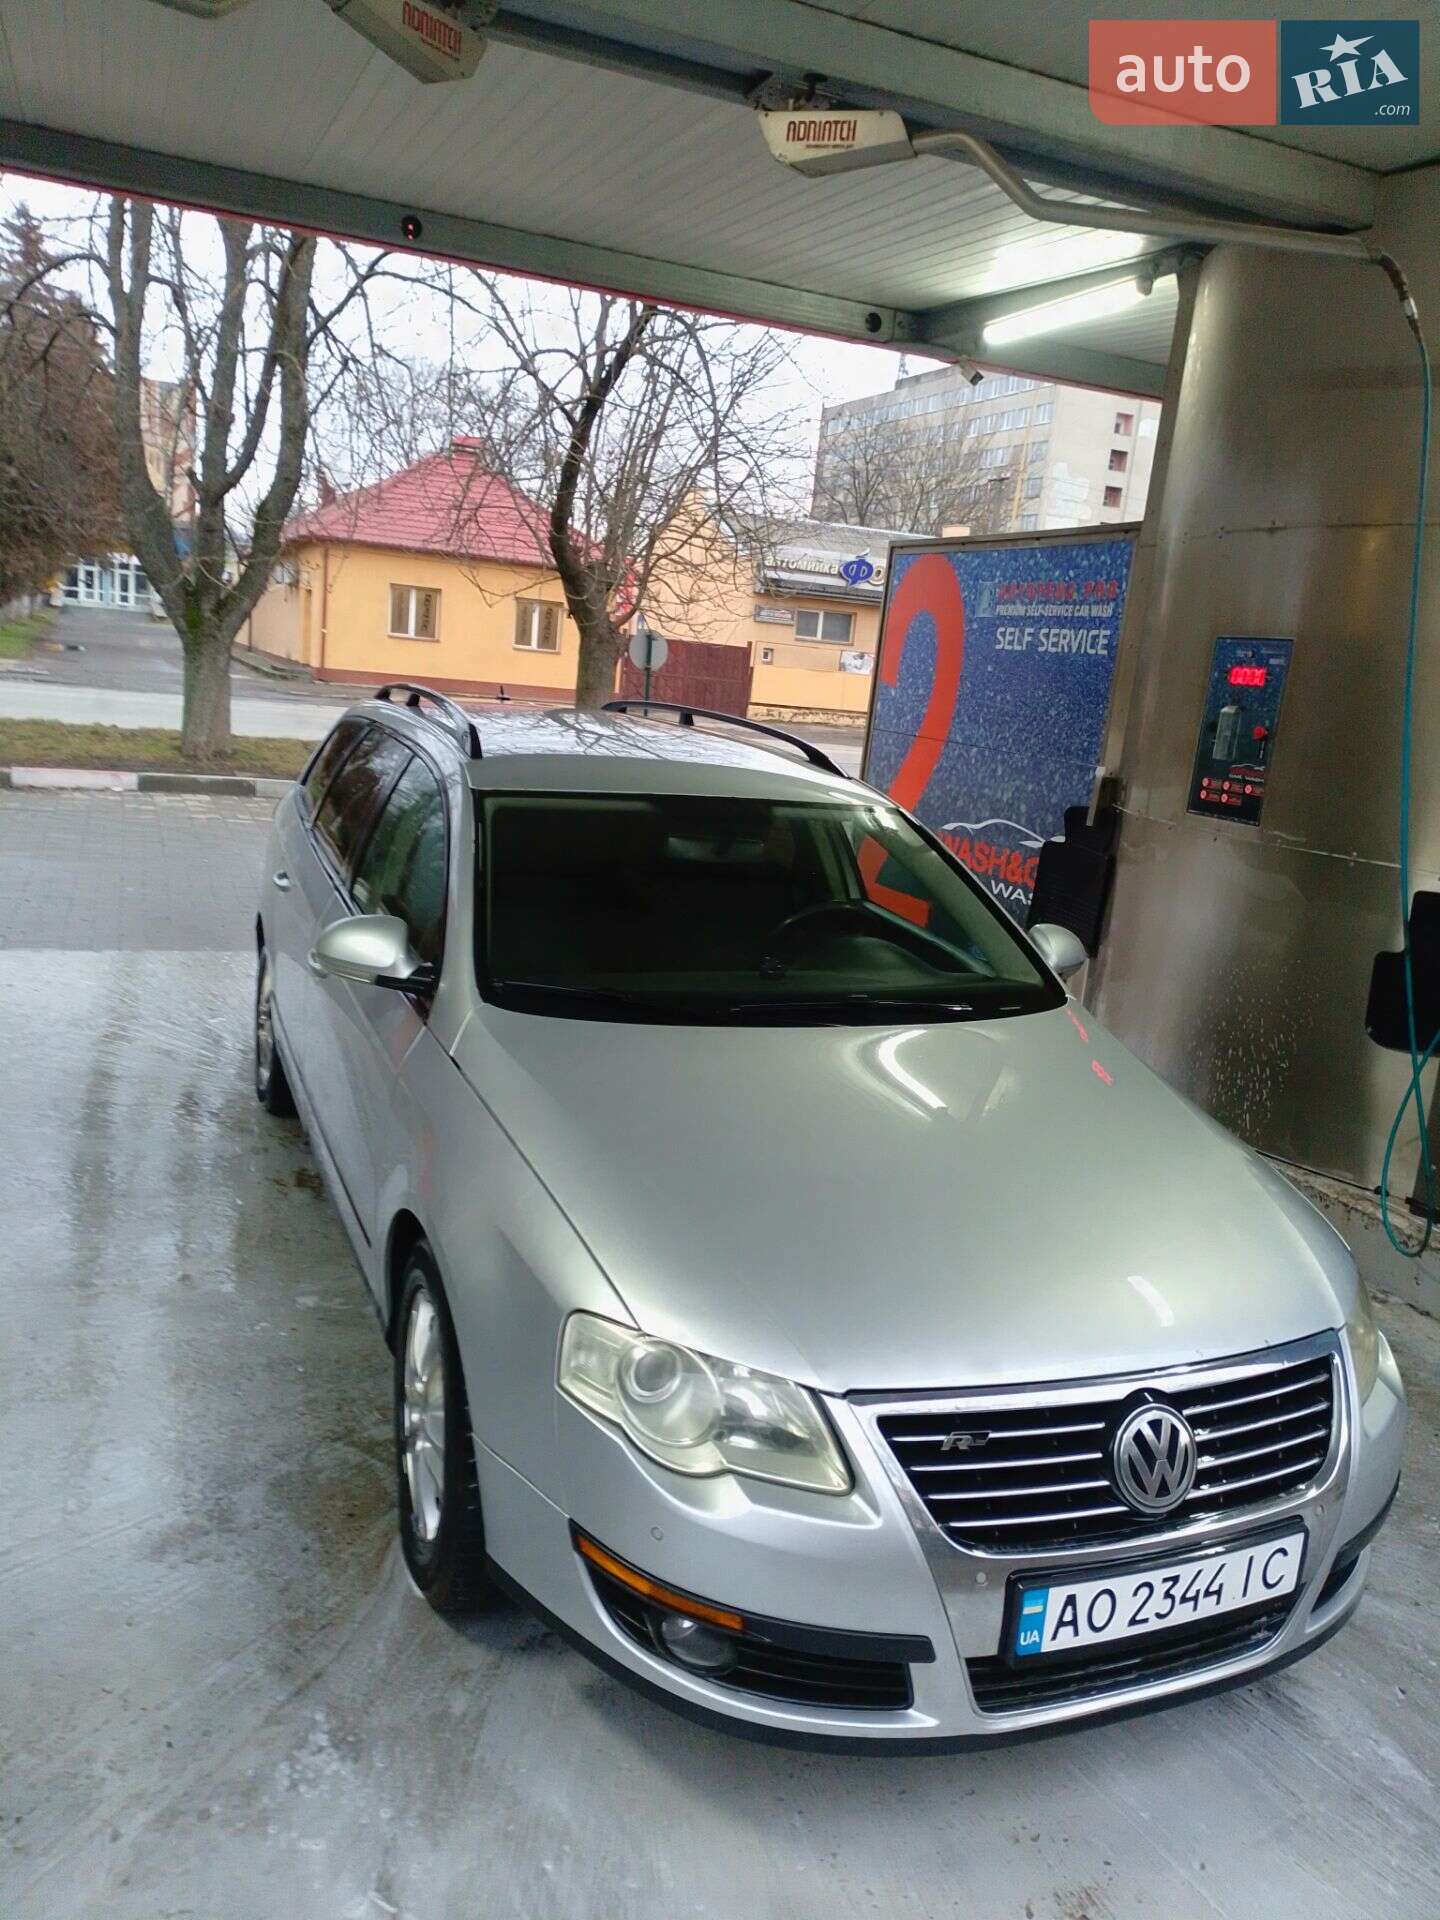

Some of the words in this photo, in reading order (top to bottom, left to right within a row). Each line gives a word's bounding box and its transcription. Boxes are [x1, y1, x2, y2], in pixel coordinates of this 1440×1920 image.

[1090, 604, 1114, 618] WASH
[995, 626, 1035, 651] SELF
[1037, 627, 1111, 655] SERVICE
[1050, 1587, 1117, 1642] AO
[1127, 1562, 1227, 1628] 2344
[1242, 1546, 1289, 1599] IC
[1020, 1631, 1041, 1647] UA
